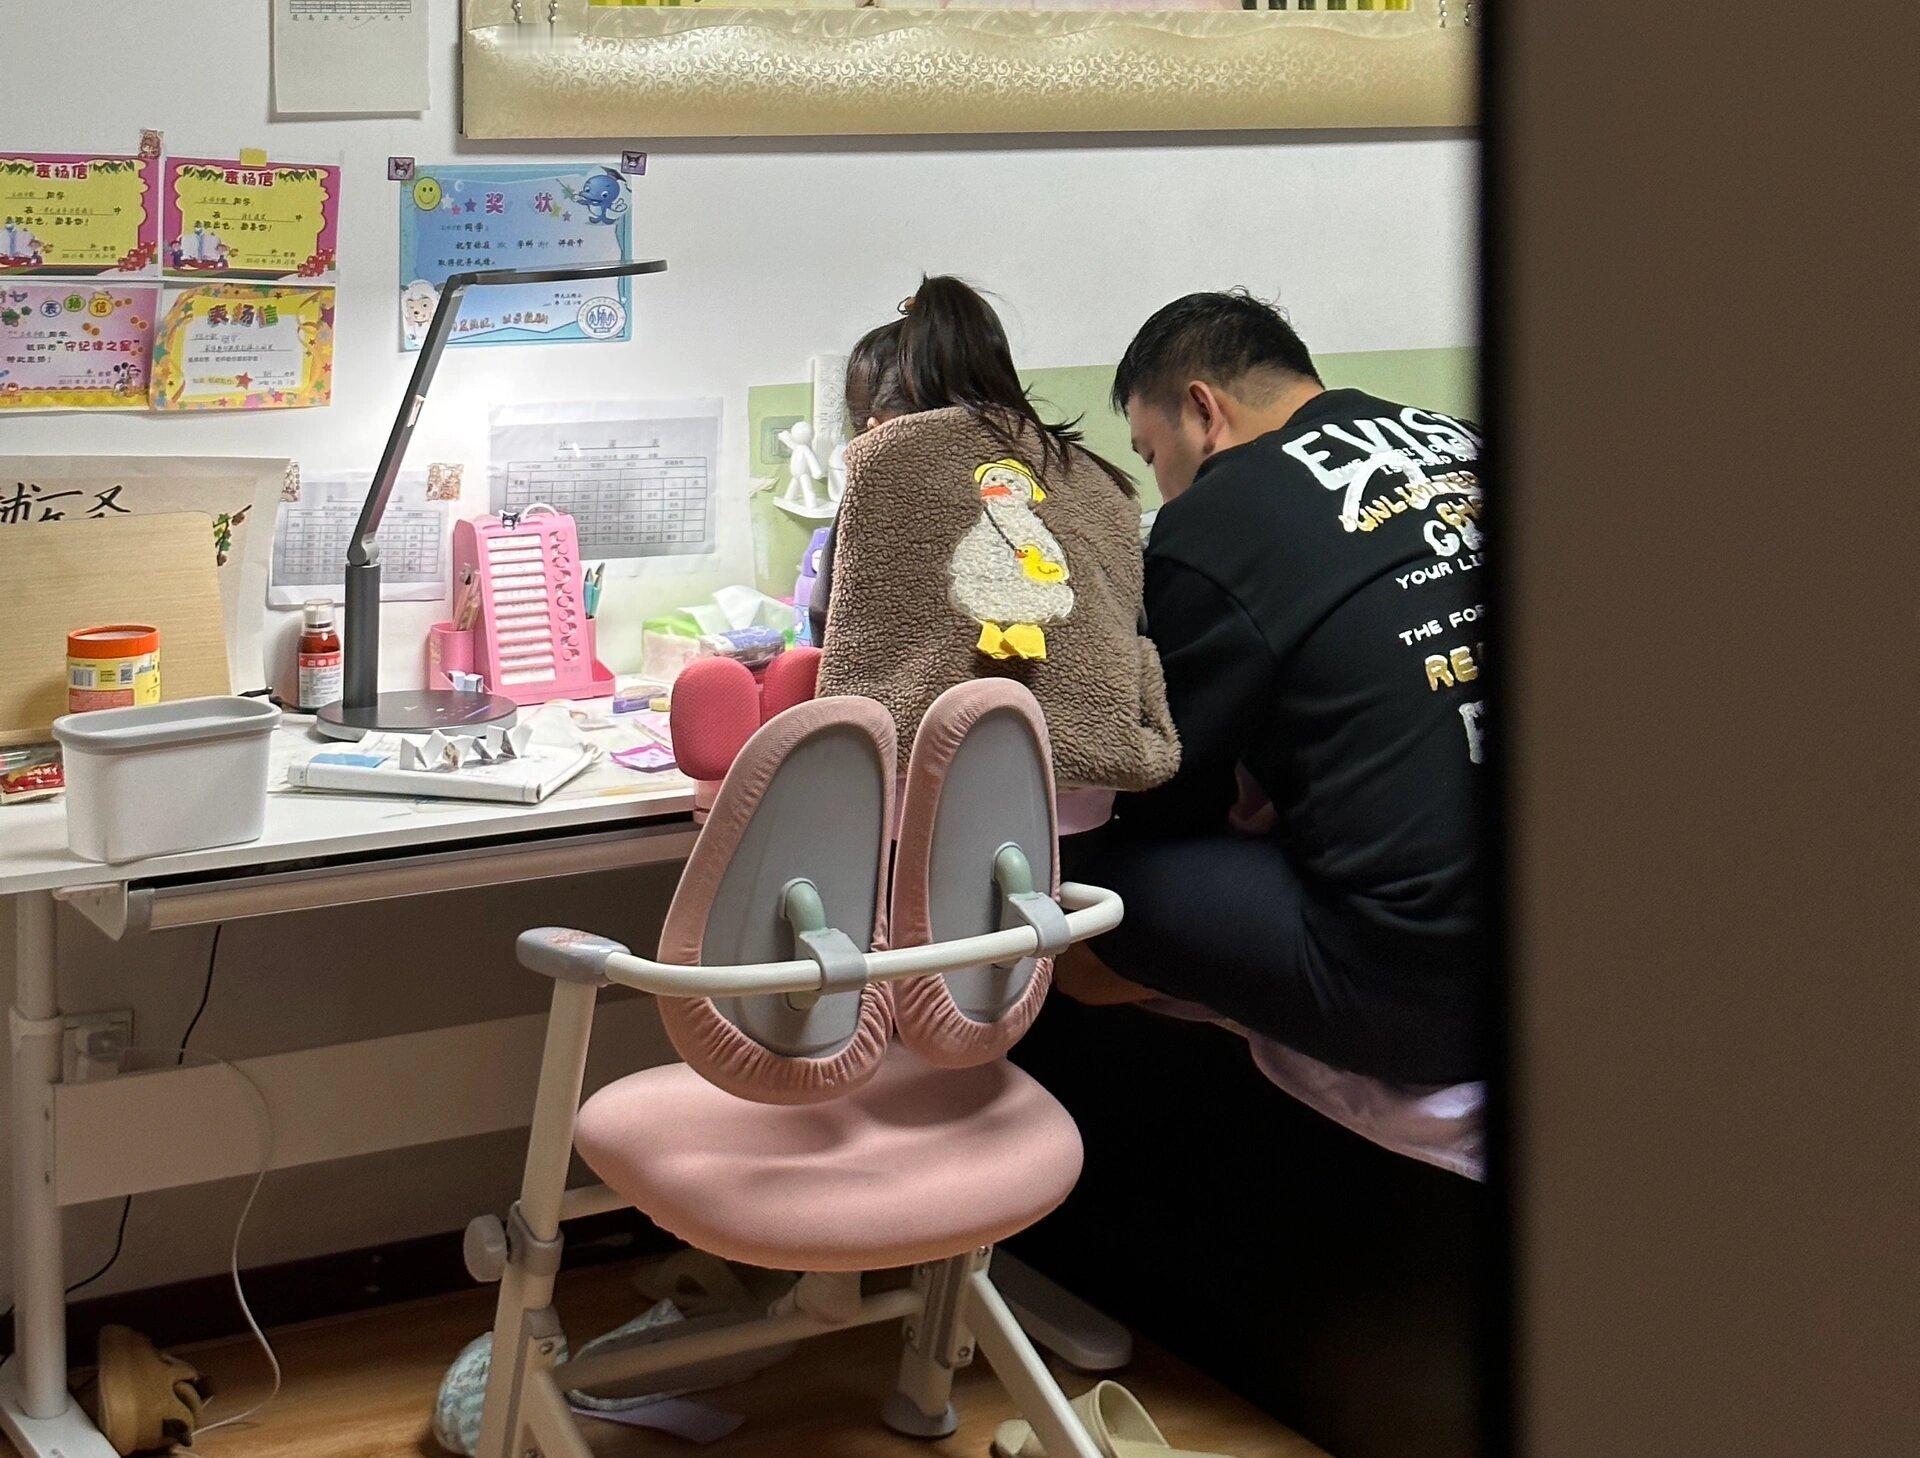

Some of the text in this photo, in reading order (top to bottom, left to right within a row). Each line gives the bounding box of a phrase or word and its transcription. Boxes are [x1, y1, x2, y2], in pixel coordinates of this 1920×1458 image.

[36, 164, 88, 179] 表扬信
[225, 171, 274, 187] 表扬信
[485, 191, 553, 214] 奖 状
[207, 303, 279, 328] 表扬信
[1396, 561, 1453, 590] YOUR
[1399, 619, 1443, 646] THE
[1425, 645, 1481, 692] RE
